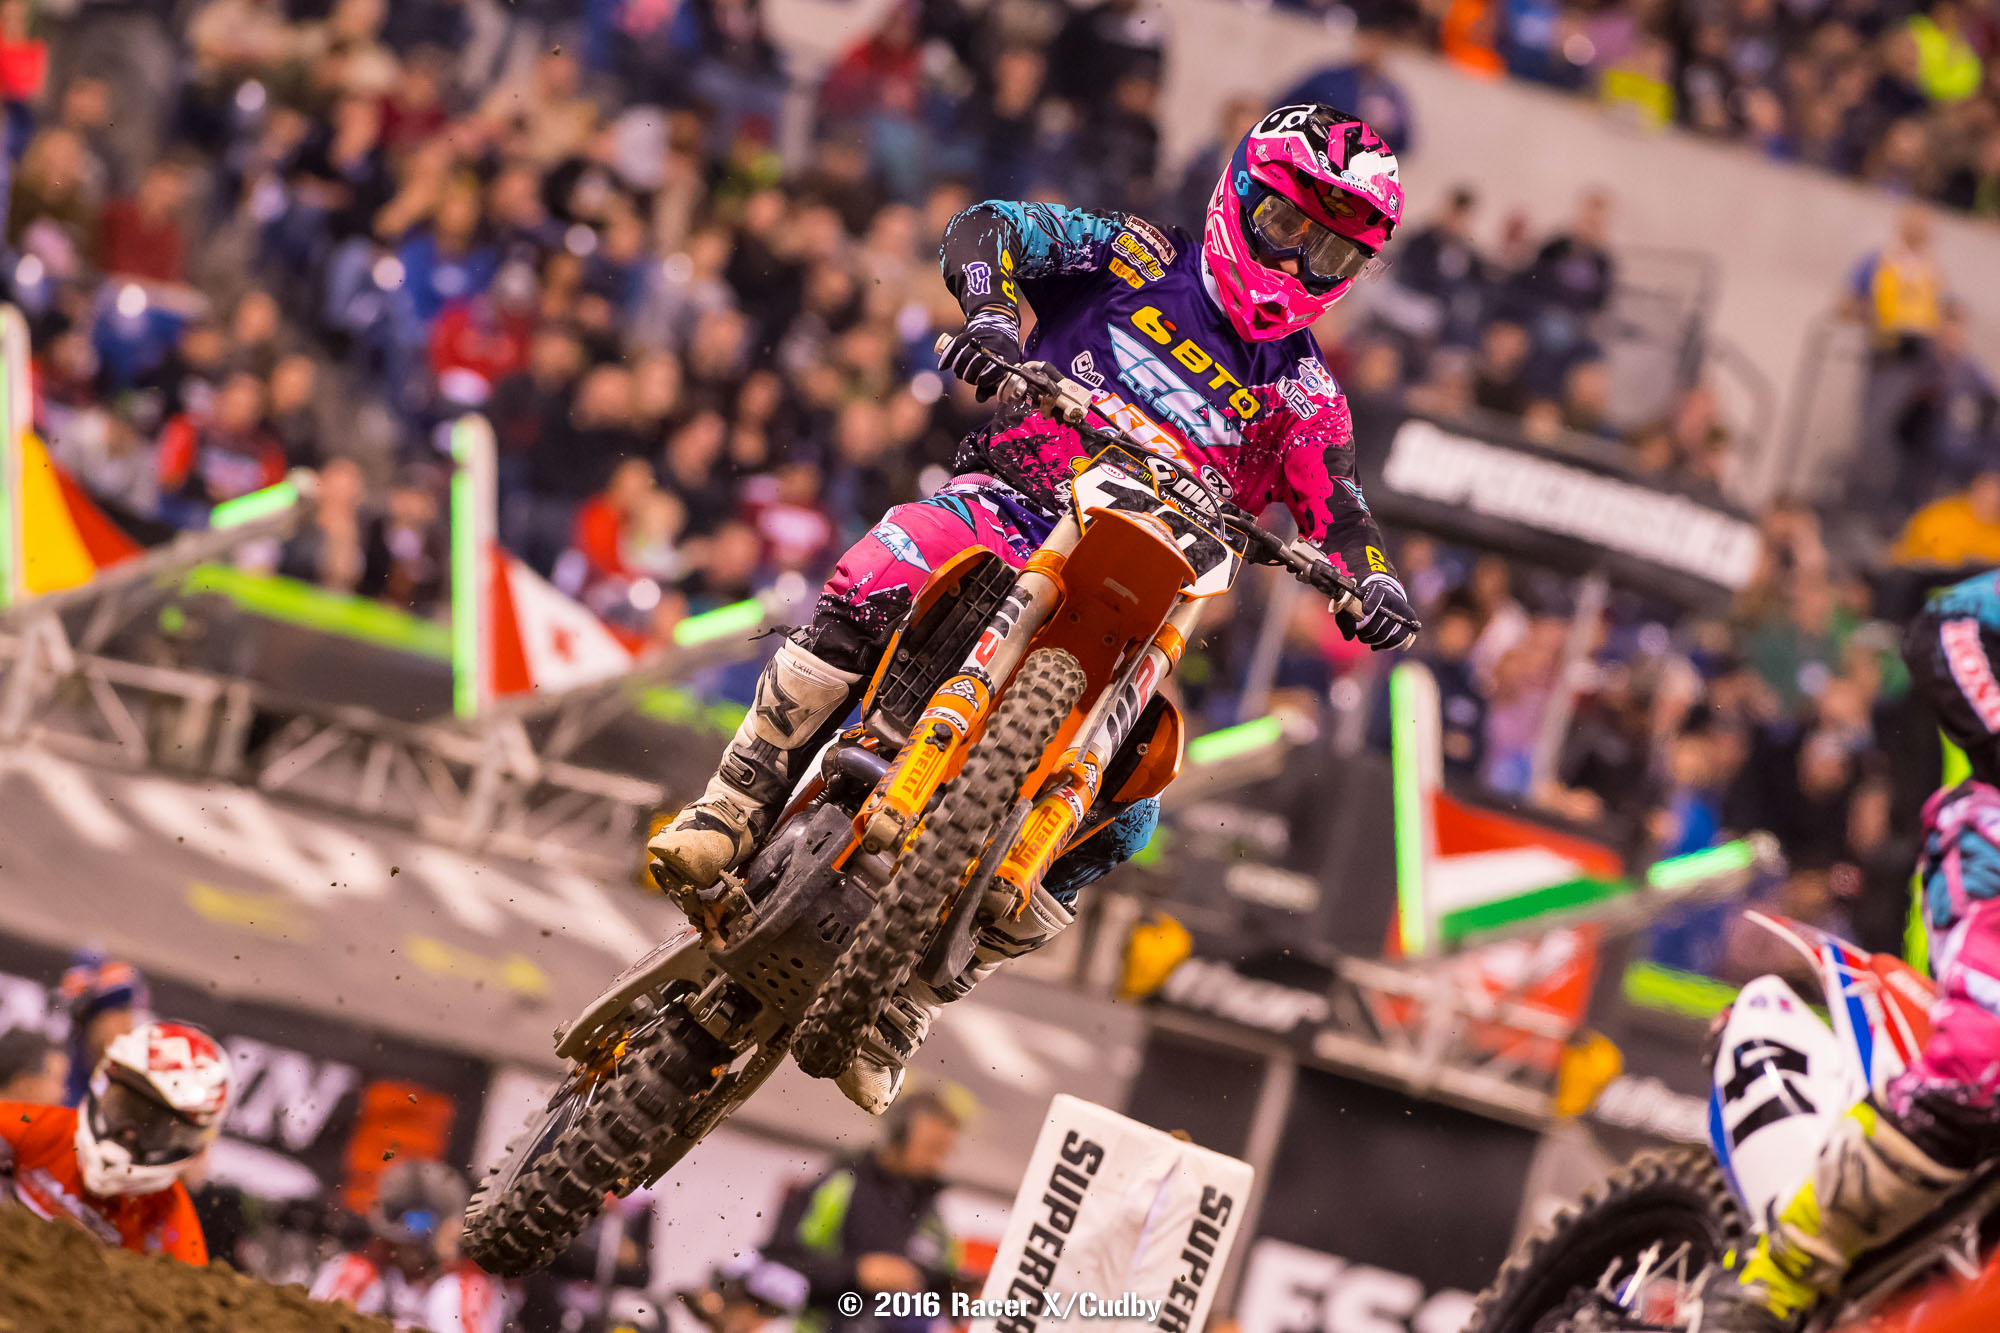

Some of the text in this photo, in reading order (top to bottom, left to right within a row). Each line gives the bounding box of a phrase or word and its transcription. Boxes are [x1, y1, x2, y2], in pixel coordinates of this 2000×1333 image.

[1118, 233, 1152, 267] Engine
[1147, 255, 1164, 278] Ice
[1117, 371, 1209, 448] RACING
[1170, 338, 1261, 420] BTO
[1160, 490, 1211, 528] MONSTER
